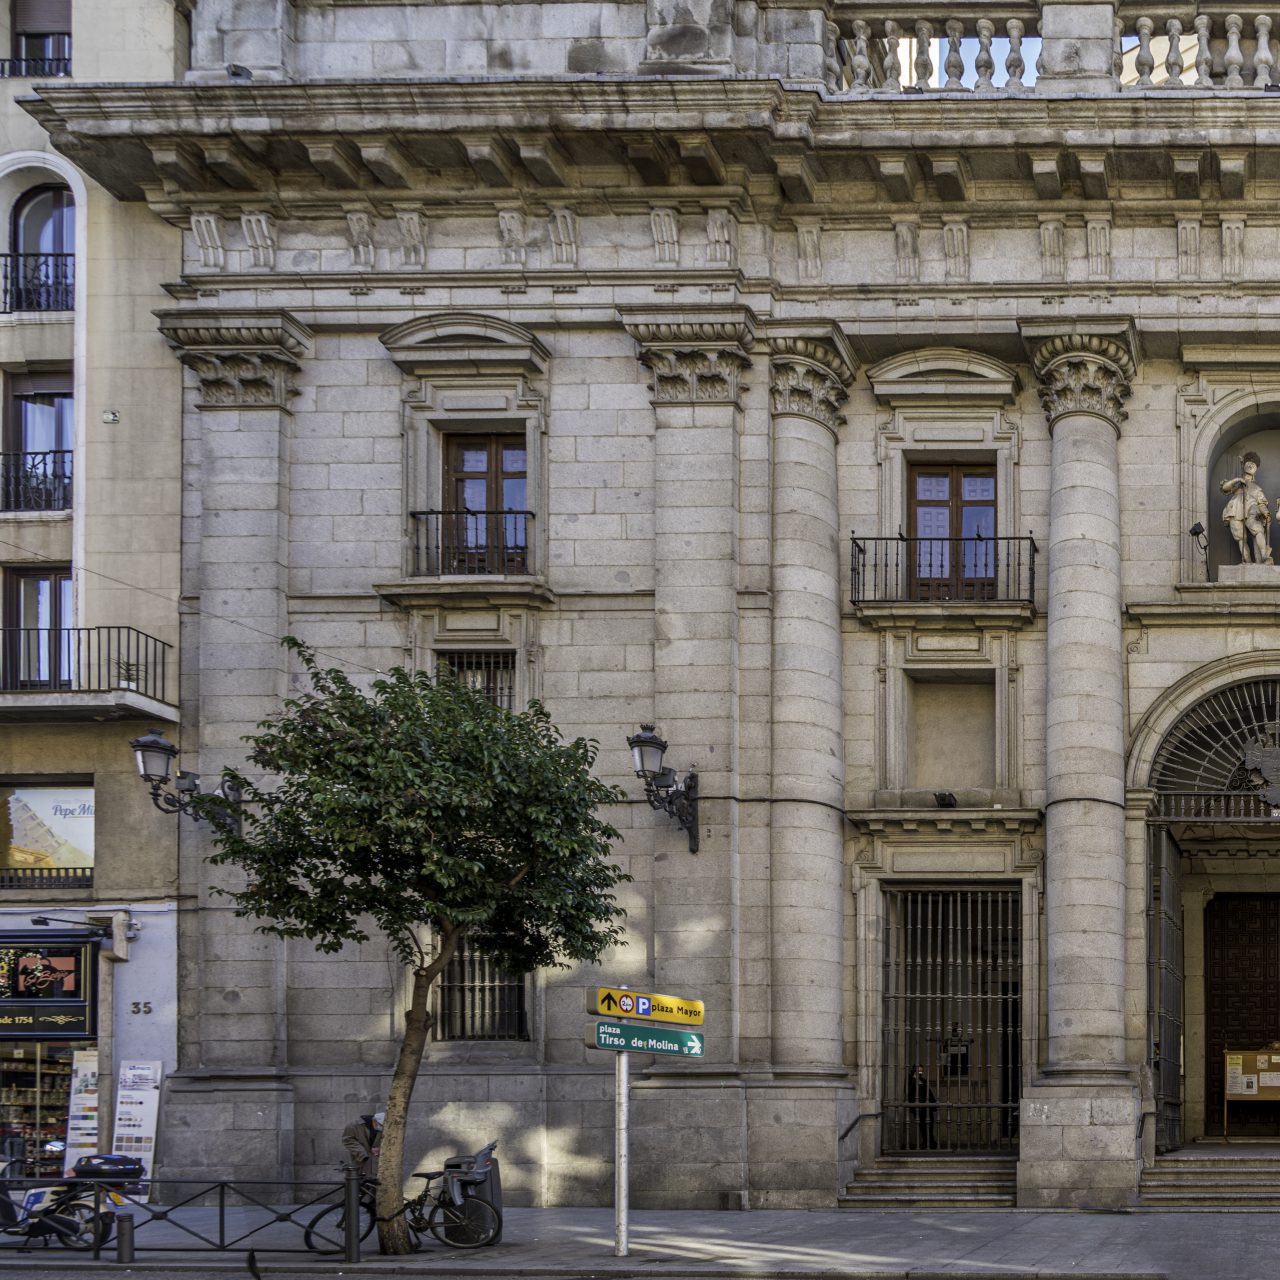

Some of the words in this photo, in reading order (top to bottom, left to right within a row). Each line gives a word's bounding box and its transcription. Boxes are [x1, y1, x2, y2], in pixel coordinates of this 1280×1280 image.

[52, 804, 77, 819] Pepe
[131, 1001, 152, 1015] 35
[638, 998, 650, 1014] P
[652, 1004, 673, 1013] plaza
[677, 1006, 701, 1017] Mayor
[14, 1016, 34, 1024] 1754
[599, 1024, 621, 1034] plaza
[599, 1034, 626, 1046] Tirso
[631, 1037, 643, 1048] de
[648, 1039, 679, 1051] Molina
